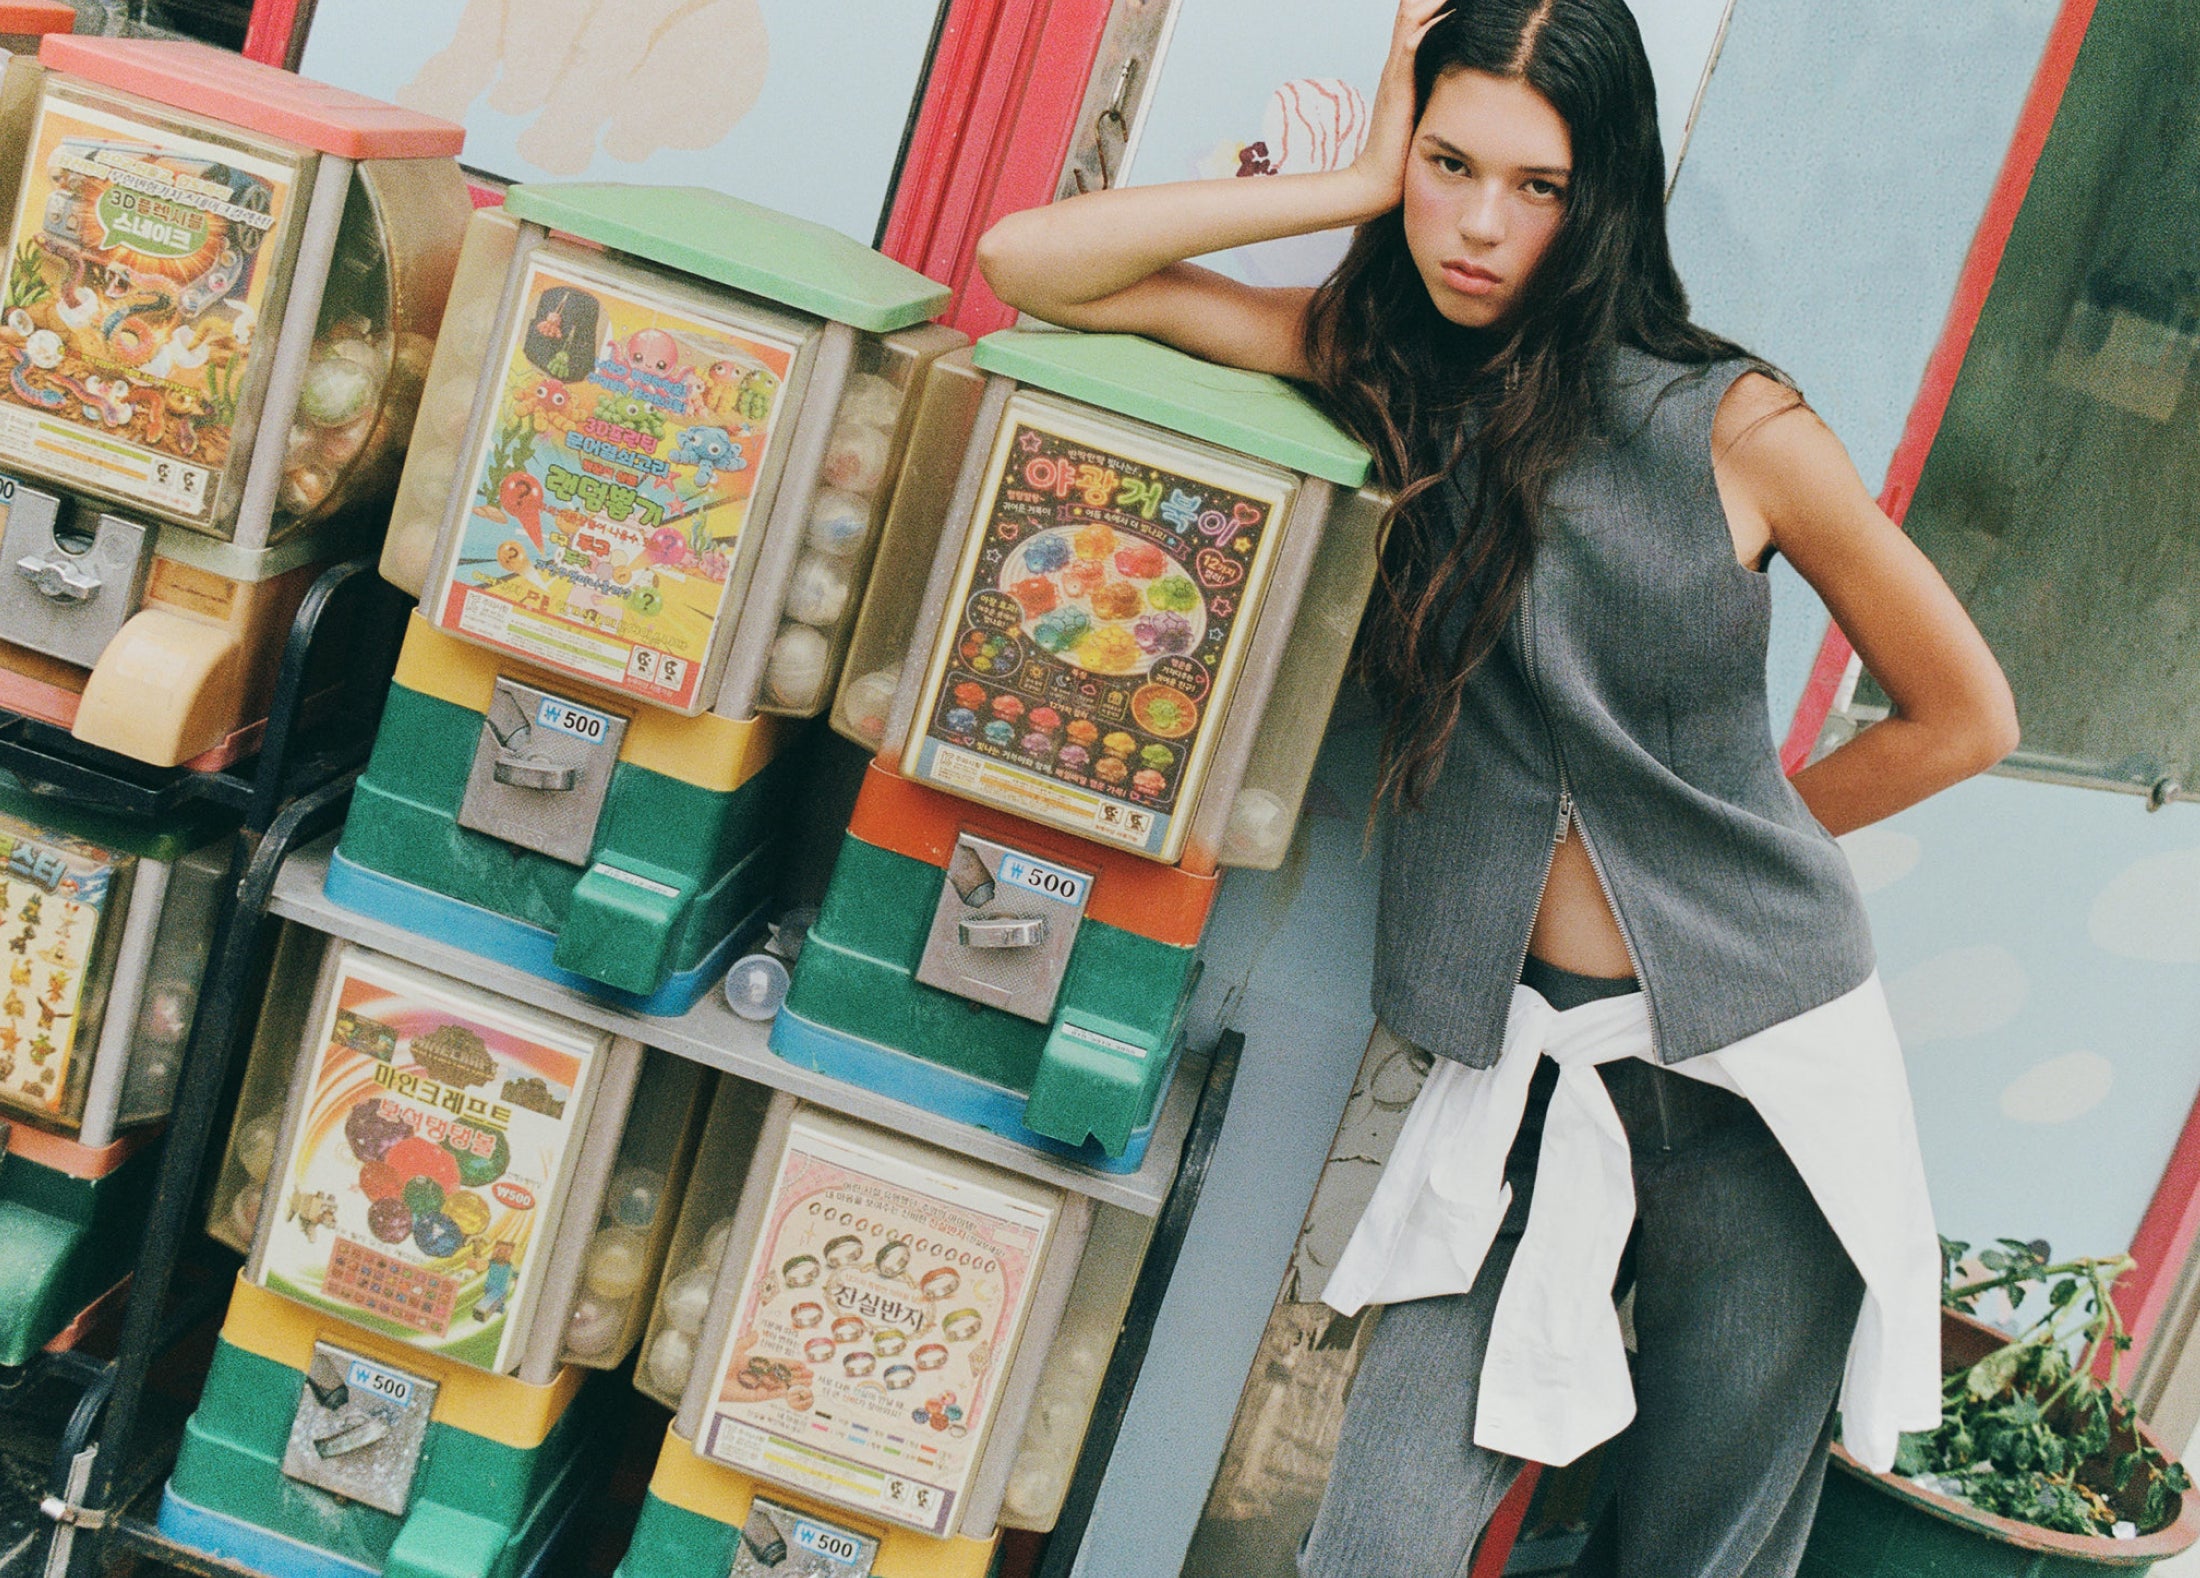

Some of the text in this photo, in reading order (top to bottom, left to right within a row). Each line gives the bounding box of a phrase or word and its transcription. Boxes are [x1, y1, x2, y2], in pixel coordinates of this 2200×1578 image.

[109, 189, 204, 231] 3D플렉시블
[111, 211, 194, 251] 스네이크
[564, 429, 671, 479] 문어열쇠고리
[583, 415, 658, 455] 3D프린팅
[541, 461, 667, 534] 랜덤뽑기
[1024, 455, 1241, 548] 야광거북이
[1201, 553, 1238, 577] 12가지
[563, 709, 601, 738] 500
[1028, 868, 1077, 899] 500
[370, 1062, 514, 1132] 마인크레프트
[375, 1097, 498, 1160] 보석탱탱볼
[831, 1281, 925, 1332] 진실반지
[372, 1372, 407, 1400] 500
[817, 1532, 855, 1559] 500
